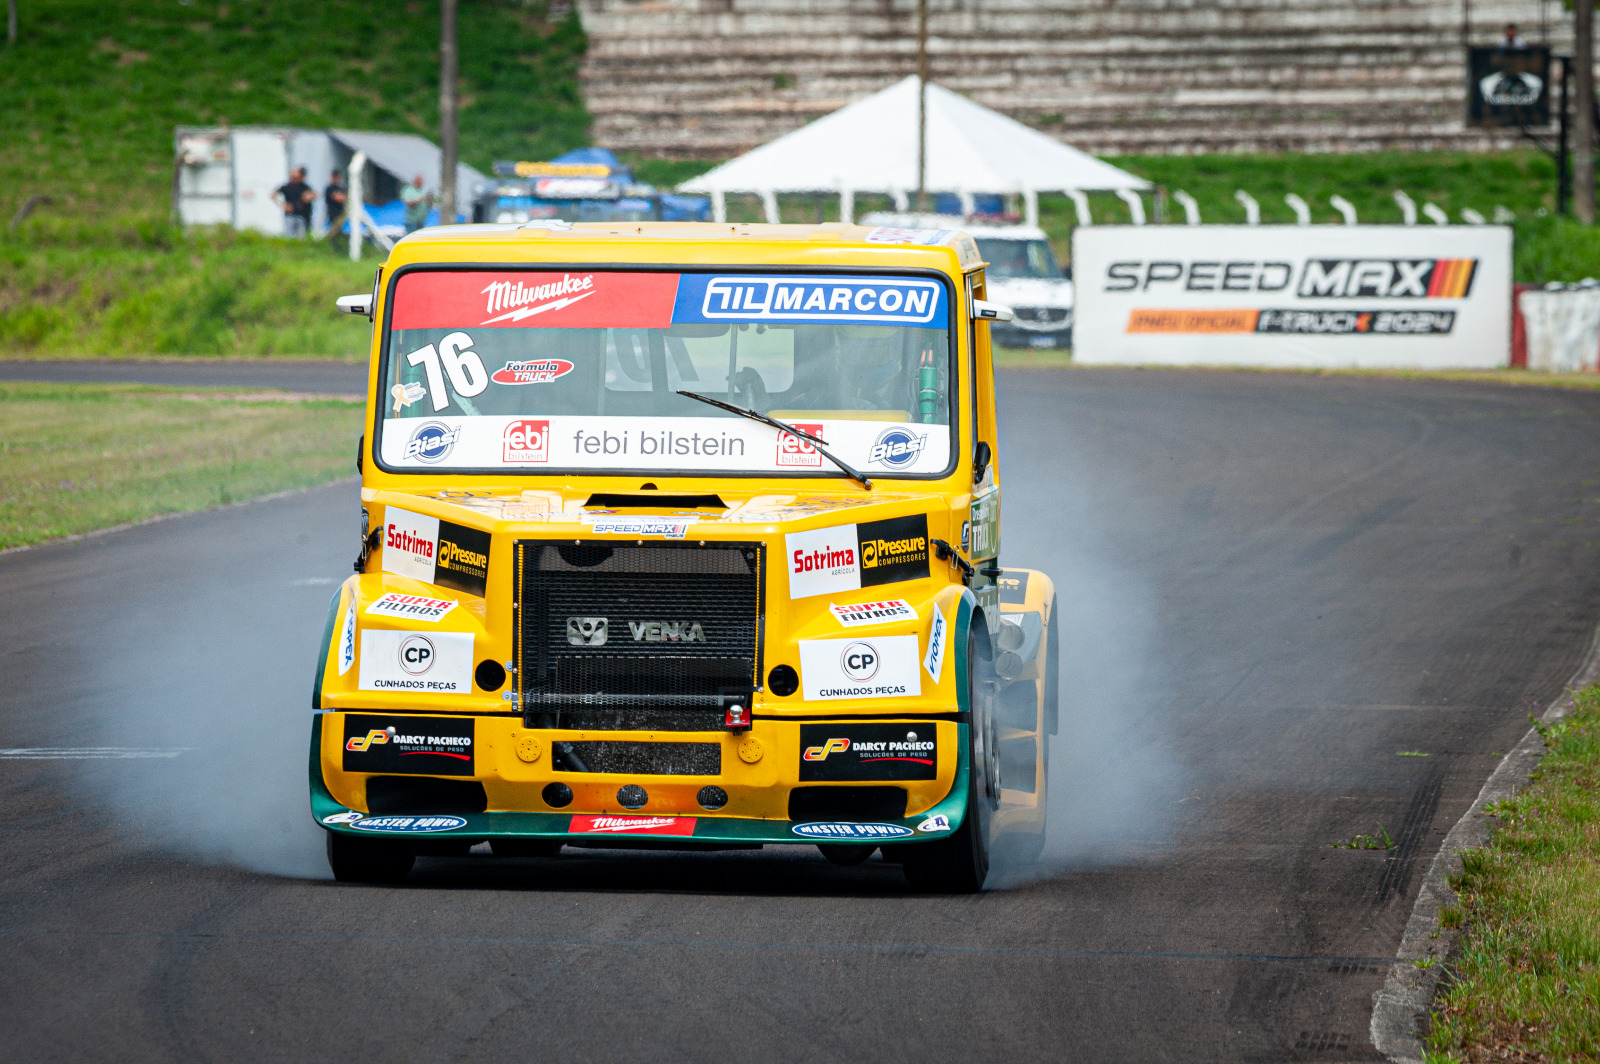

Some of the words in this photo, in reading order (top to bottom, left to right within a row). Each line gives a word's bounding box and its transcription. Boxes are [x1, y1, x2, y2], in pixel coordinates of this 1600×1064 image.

[480, 274, 593, 314] Milwaukee
[774, 287, 930, 314] MARCON
[1374, 311, 1454, 333] 2024
[406, 331, 489, 412] 76
[513, 371, 555, 382] TRUCK
[403, 424, 462, 460] Biasi
[503, 421, 548, 450] febi
[573, 430, 628, 454] febi
[641, 431, 745, 456] bilstein
[868, 432, 928, 463] Biasi
[508, 451, 543, 461] bilstein
[782, 455, 816, 464] bilstein
[387, 523, 434, 558] Sotrima
[878, 536, 926, 557] Pressure
[450, 542, 487, 569] Pressure
[793, 545, 854, 573] Sotrima
[878, 552, 926, 566] COMPRESSORES
[376, 600, 443, 616] FILTROS
[385, 594, 453, 609] SUPER
[834, 600, 903, 614] SUPER
[840, 607, 910, 622] FILTROS
[628, 621, 706, 642] VENKA
[405, 647, 431, 663] CP
[847, 654, 874, 670] CP
[374, 680, 425, 689] CUNHADOS
[427, 681, 456, 691] PEÇAS
[819, 687, 873, 697] CUNHADOS
[875, 686, 906, 695] PEÇAS
[393, 734, 425, 744] DARCY
[427, 736, 472, 746] PACHECO
[852, 742, 887, 751] DARCY
[888, 741, 934, 751] PACHECO
[358, 818, 411, 827] MASTER
[412, 818, 460, 827] POWER
[590, 817, 675, 828] Milwaukee
[801, 824, 855, 834] MASTER
[855, 824, 905, 834] POWER
